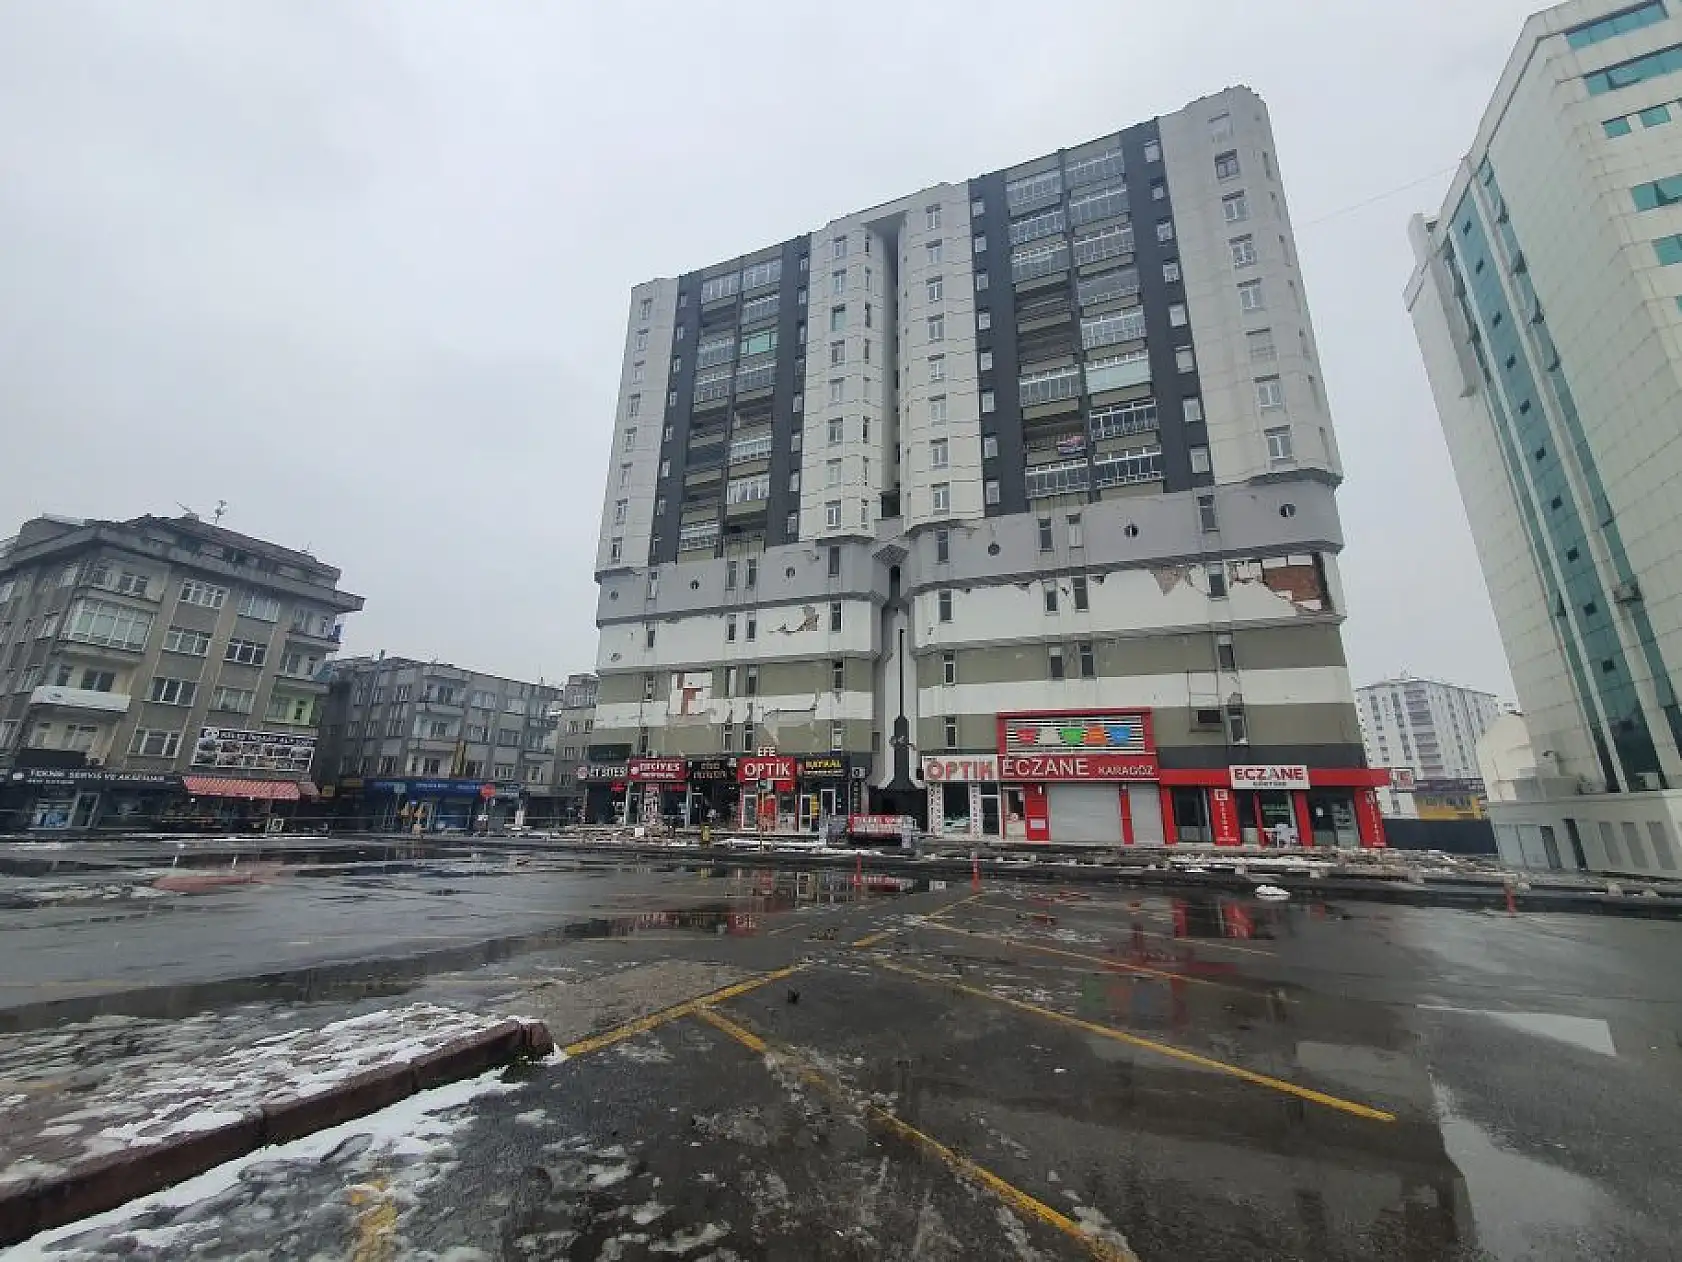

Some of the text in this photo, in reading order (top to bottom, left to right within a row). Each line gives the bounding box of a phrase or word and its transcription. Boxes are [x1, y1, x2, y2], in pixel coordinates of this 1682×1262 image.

[757, 746, 776, 757] EFE
[744, 759, 790, 777] OPTİK
[1002, 759, 1089, 775] ECZANE
[1234, 767, 1304, 780] ECZANE
